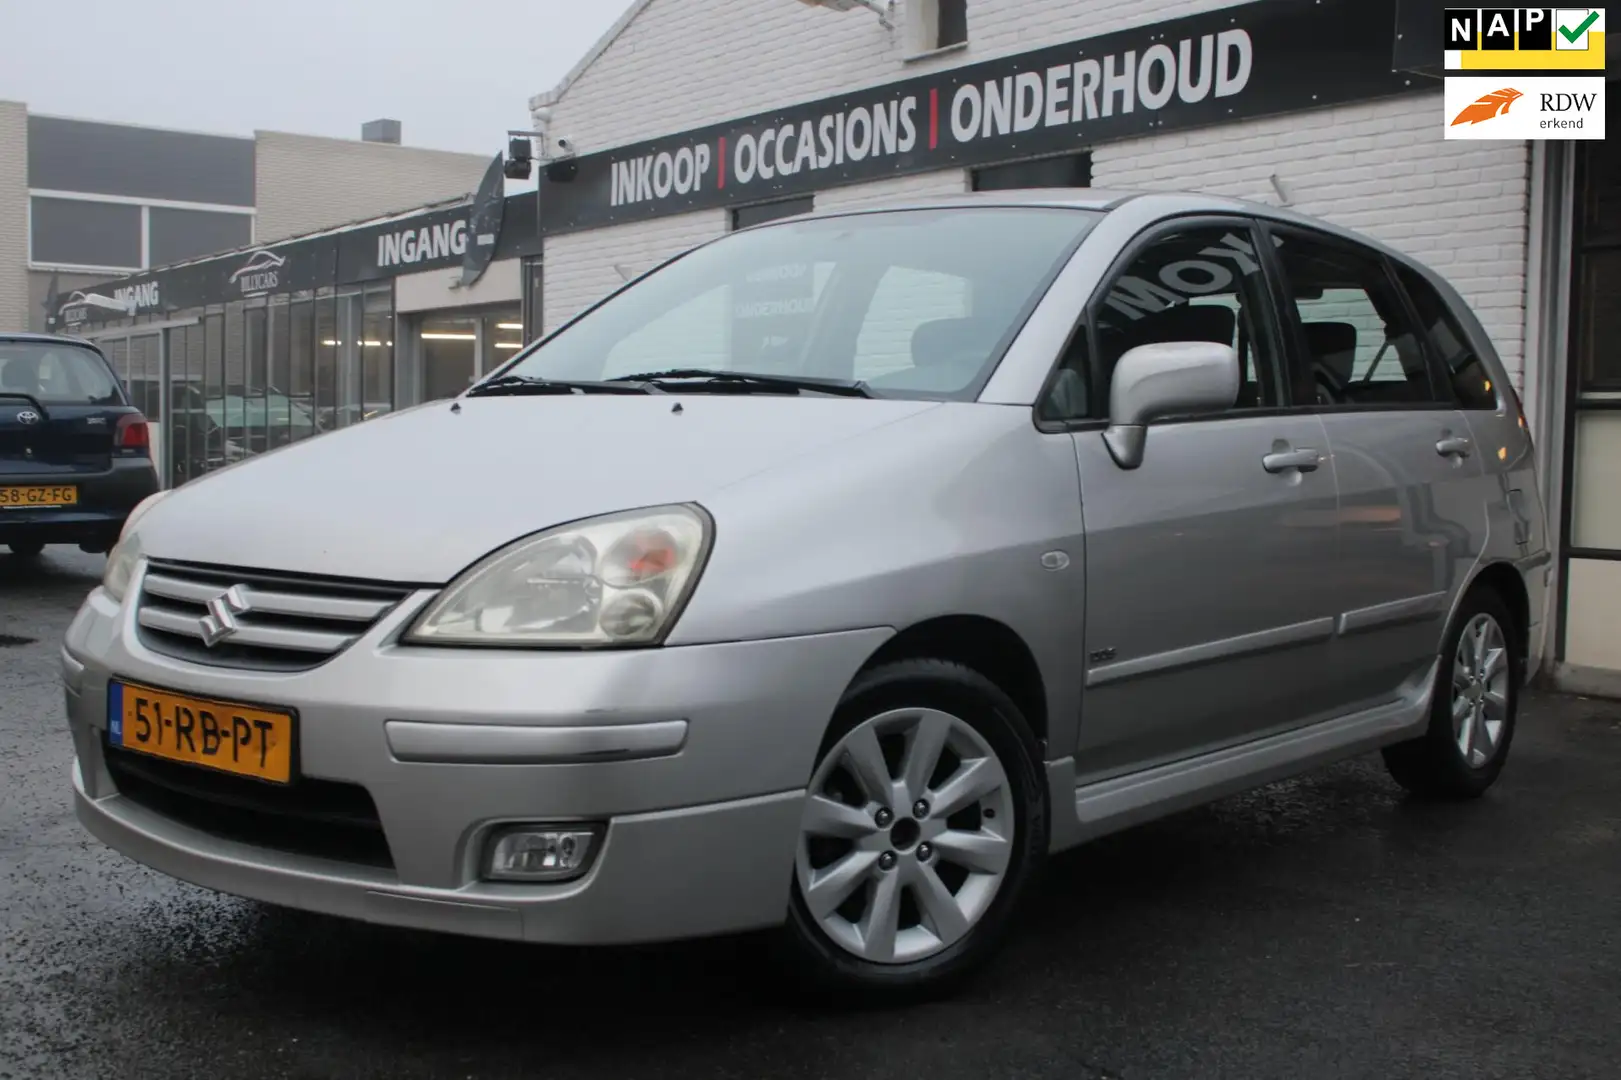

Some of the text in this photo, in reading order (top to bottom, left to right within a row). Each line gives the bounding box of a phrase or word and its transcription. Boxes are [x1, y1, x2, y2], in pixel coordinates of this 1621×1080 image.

[611, 28, 1253, 206] INKOOP OCCASIONS ONDERHOUD
[377, 219, 467, 267] INGANG
[0, 487, 73, 503] 58-GZ-FG
[135, 697, 273, 768] 51-RB-PT
